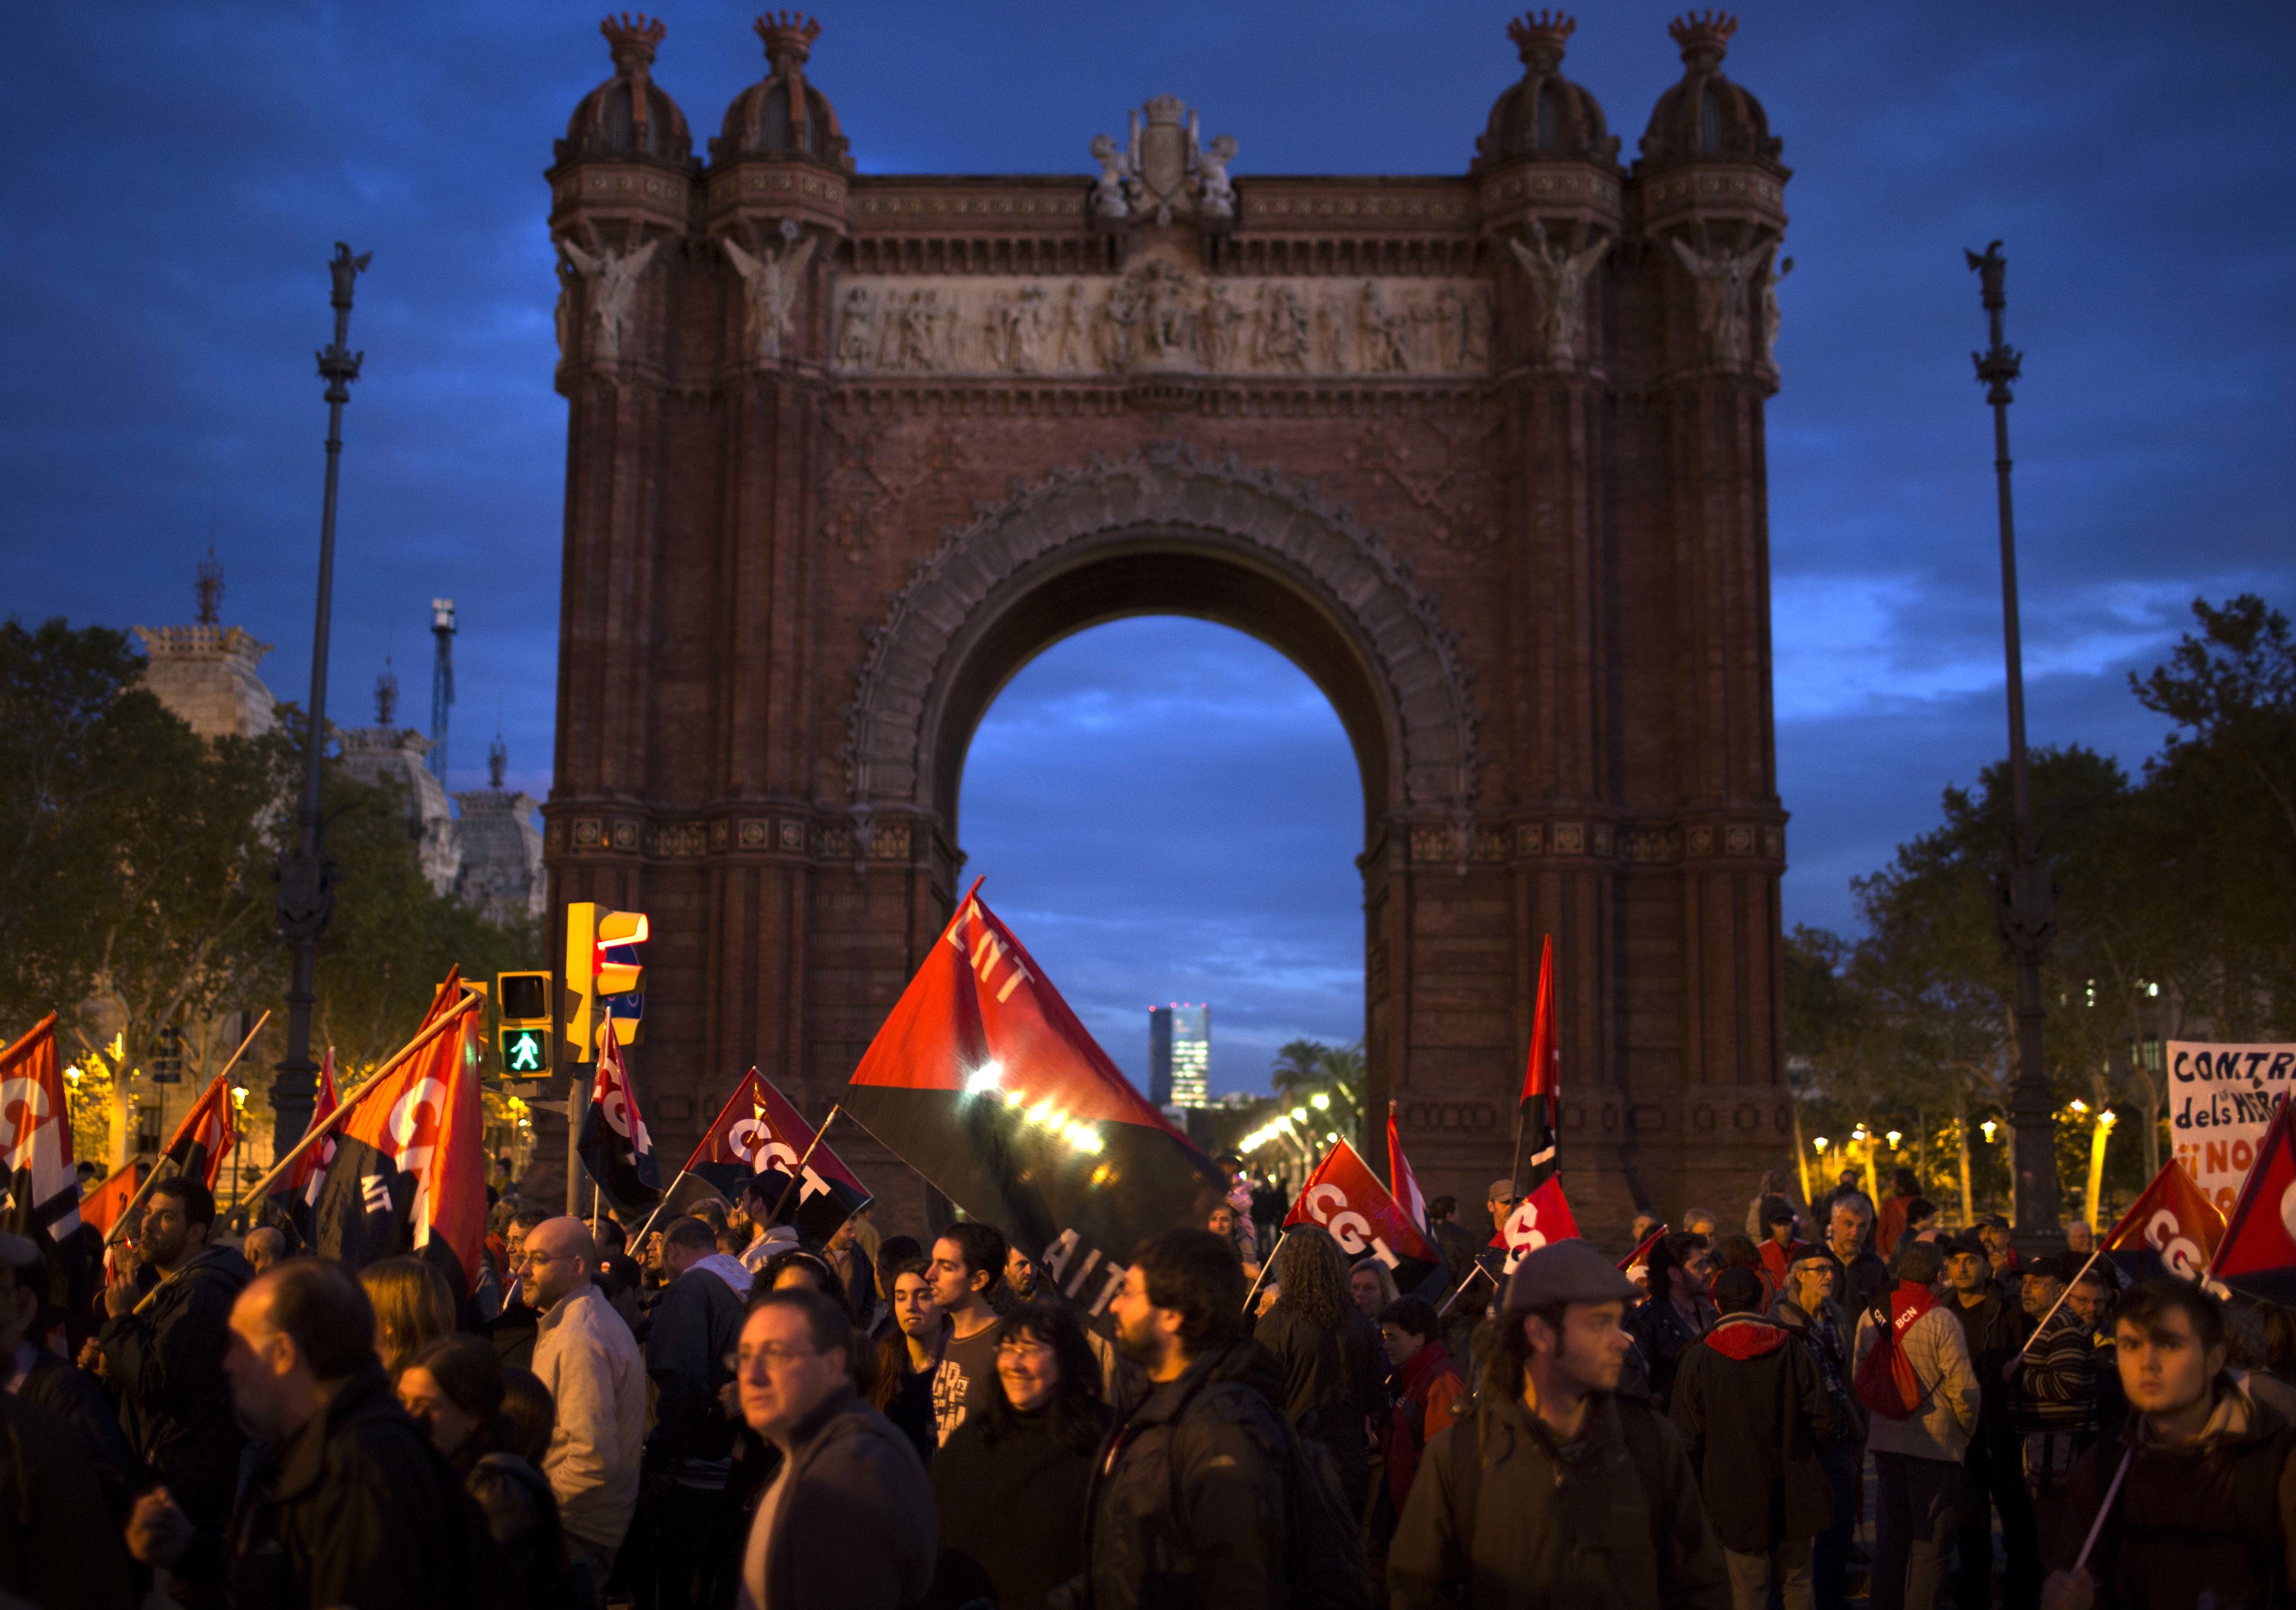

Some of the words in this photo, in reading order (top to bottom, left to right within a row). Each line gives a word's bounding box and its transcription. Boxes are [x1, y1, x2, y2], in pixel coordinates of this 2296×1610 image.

[945, 898, 1035, 1003] CNT
[2175, 1051, 2296, 1082] CONTR
[2175, 1093, 2232, 1129] dels
[1895, 1306, 1918, 1329] BCN
